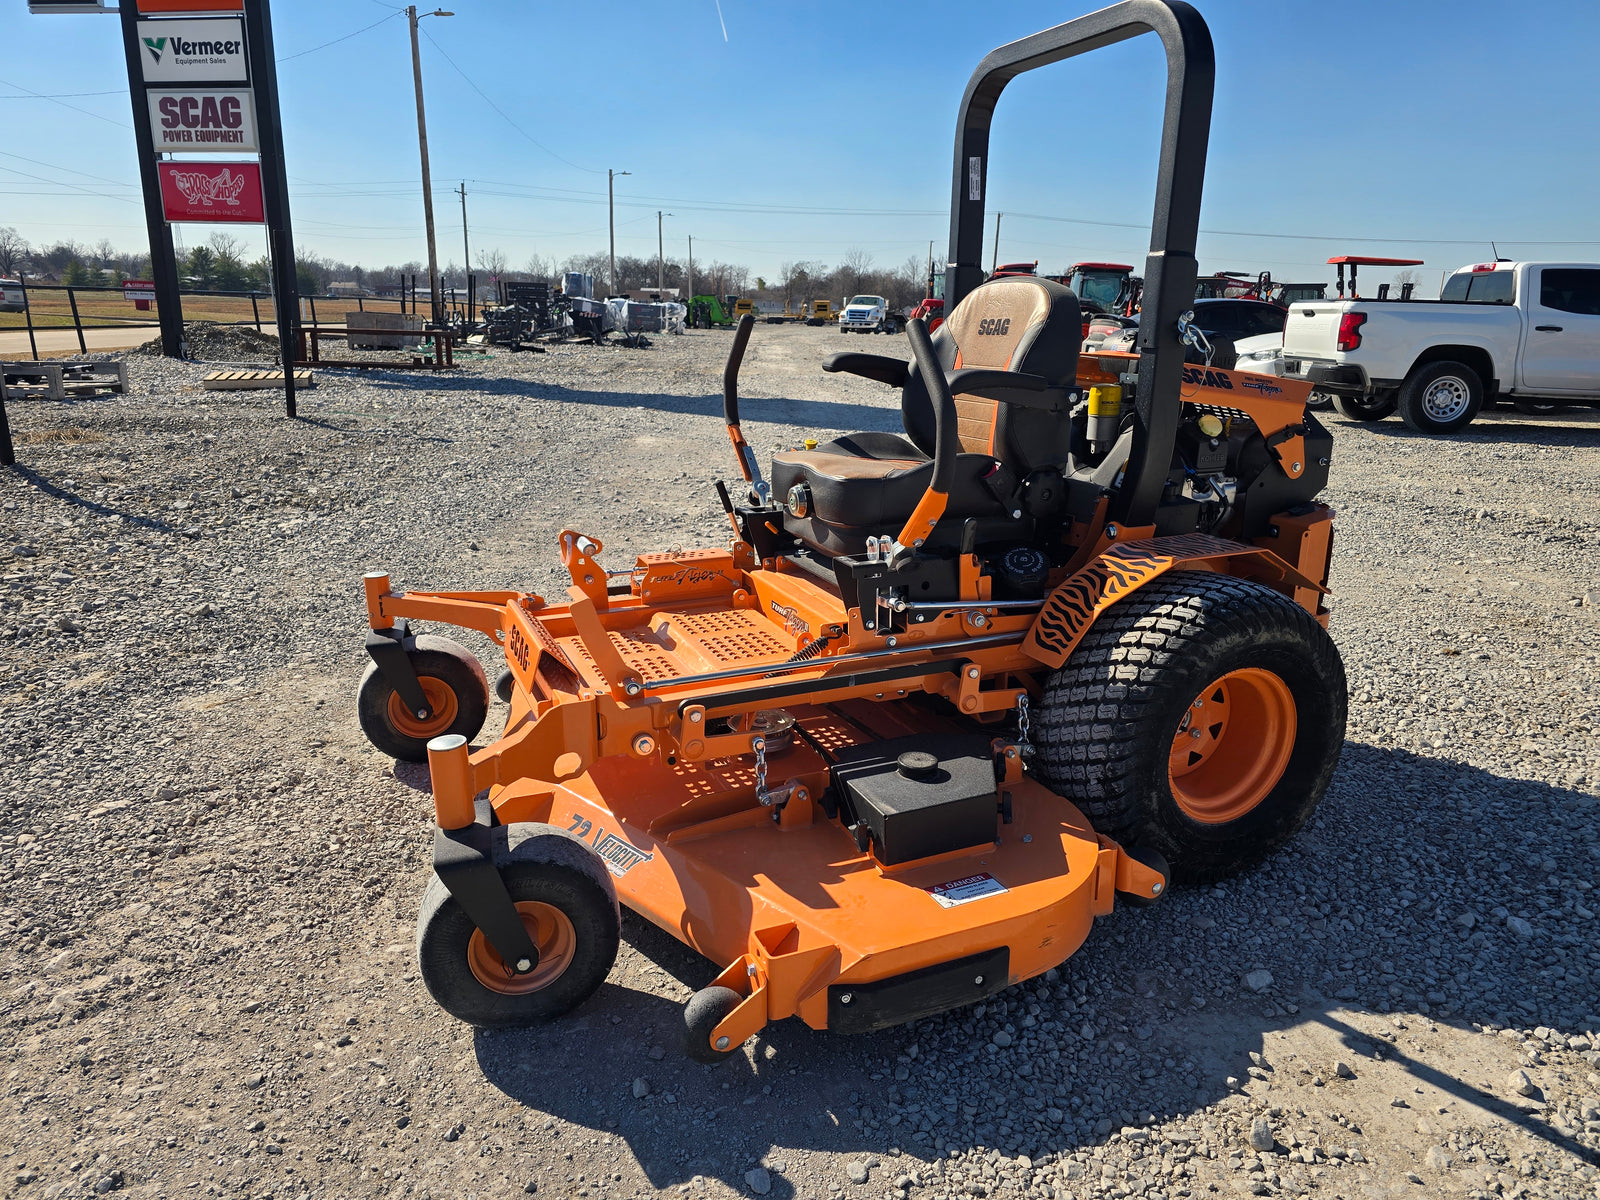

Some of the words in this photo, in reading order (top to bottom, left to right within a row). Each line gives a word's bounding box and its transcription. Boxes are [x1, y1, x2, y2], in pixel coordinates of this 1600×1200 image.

[169, 37, 241, 55] Vermeer
[175, 58, 208, 66] Equipment
[159, 96, 243, 129] SCAG
[163, 130, 194, 142] POWER
[195, 130, 244, 143] EQUIPMENT
[978, 318, 1010, 336] SCAG
[1182, 367, 1234, 389] SCAG
[677, 567, 715, 585] Tiger
[771, 601, 788, 617] TURF
[510, 624, 529, 672] SCAG
[566, 813, 593, 838] 72
[945, 875, 985, 889] DANGER
